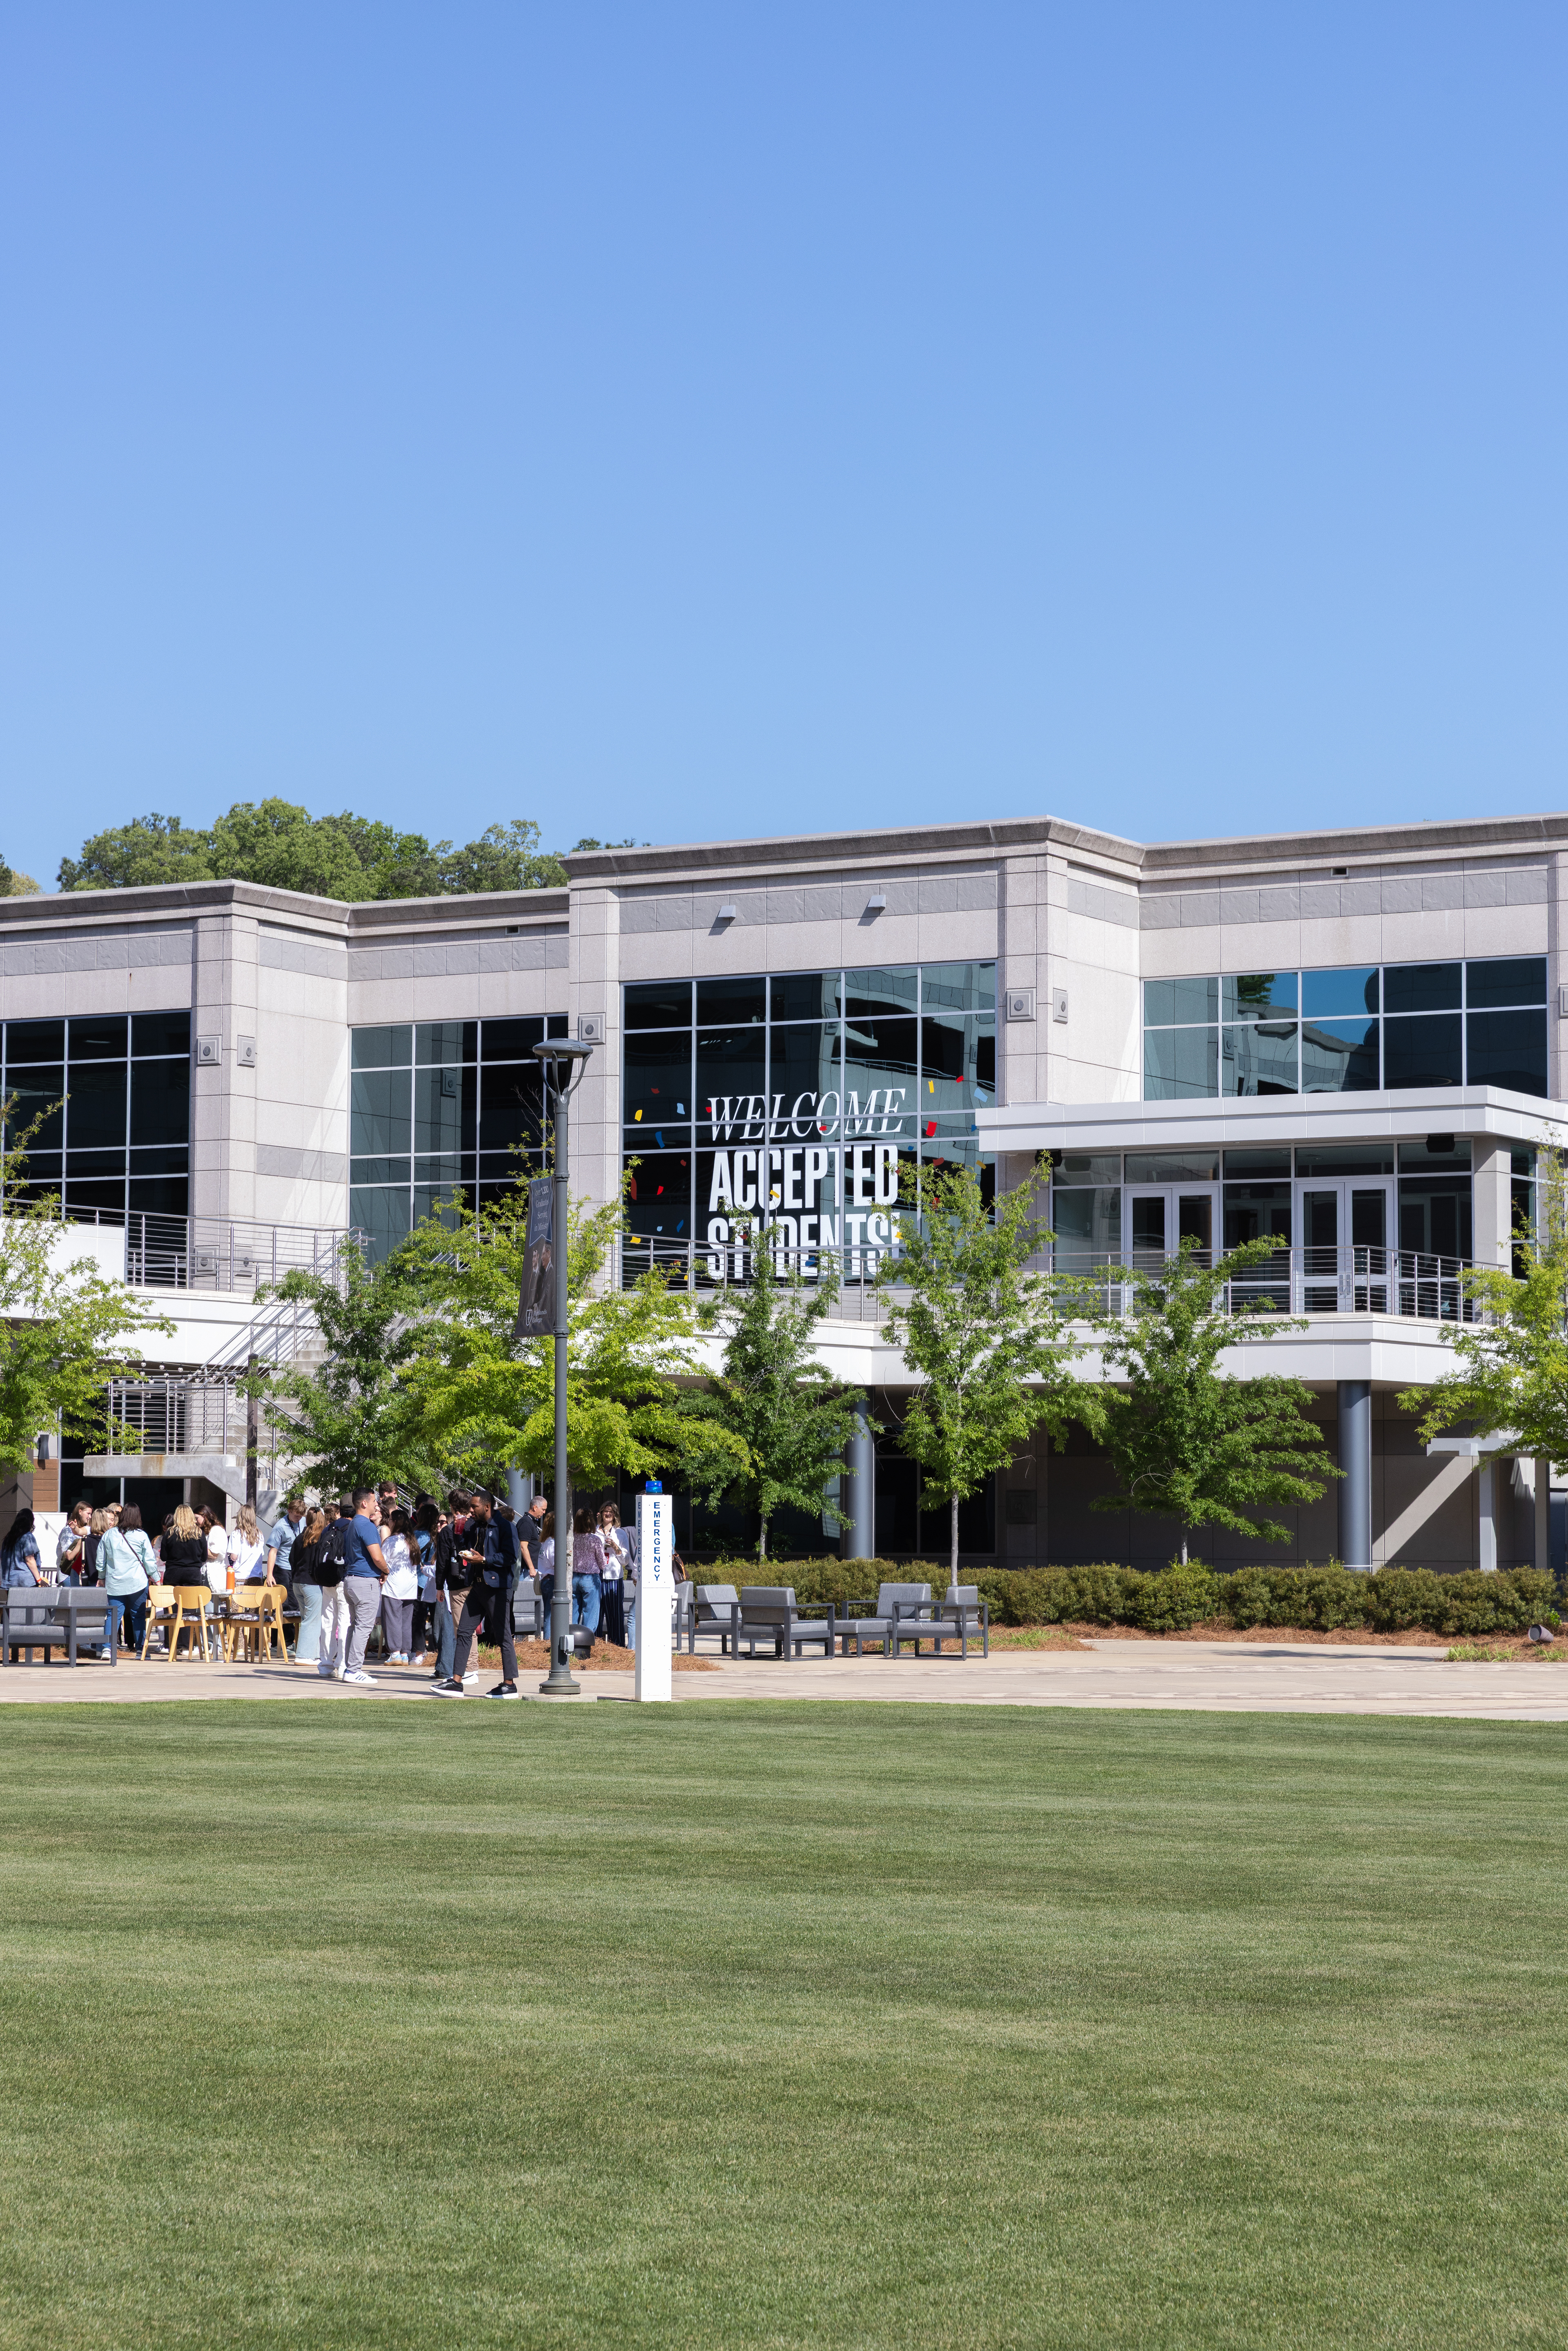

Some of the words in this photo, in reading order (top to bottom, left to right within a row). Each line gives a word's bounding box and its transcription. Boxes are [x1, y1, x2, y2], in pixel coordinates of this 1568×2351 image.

[707, 1088, 906, 1141] WELCOME
[708, 1143, 898, 1212] ACCEPTED
[536, 1199, 549, 1208] Graduates
[537, 1211, 548, 1219] Serving
[538, 1222, 549, 1231] Ministr
[707, 1211, 900, 1280] STDENTS!
